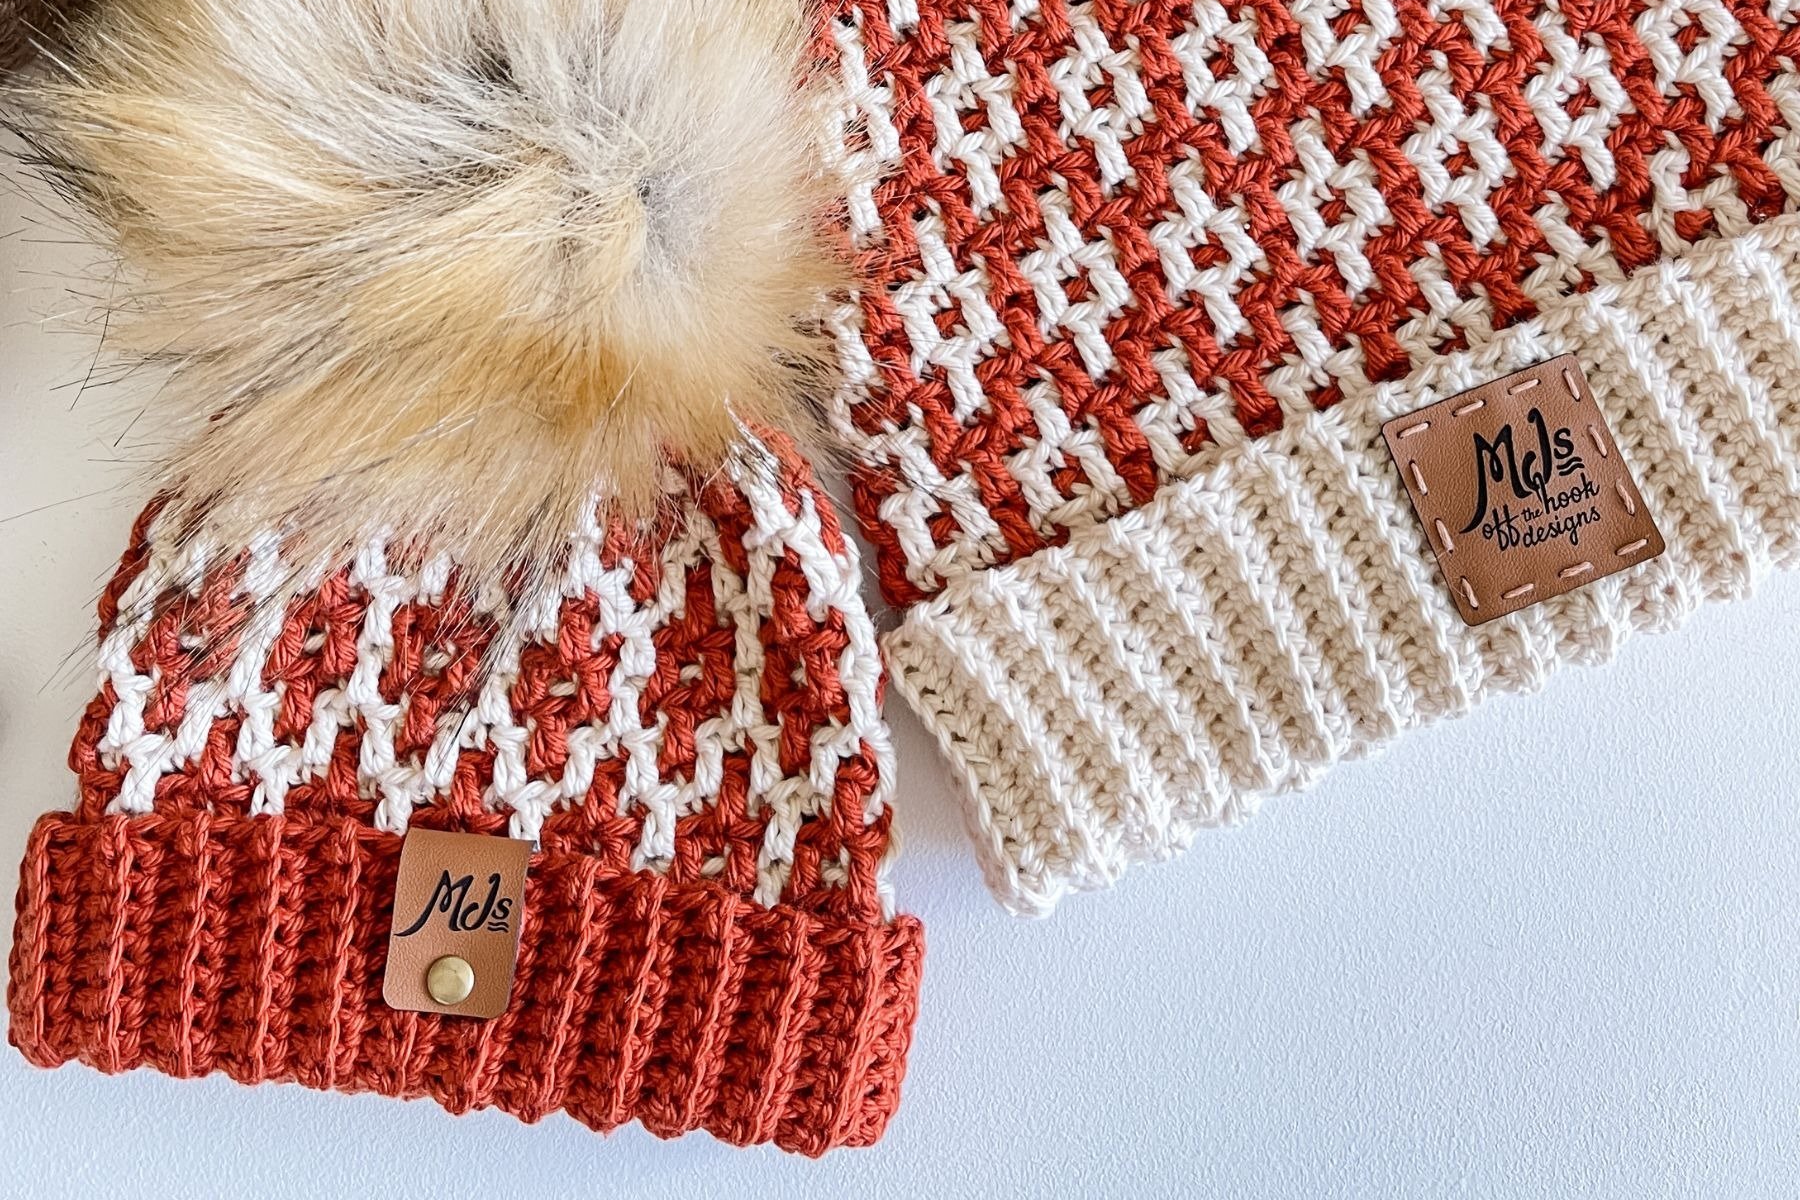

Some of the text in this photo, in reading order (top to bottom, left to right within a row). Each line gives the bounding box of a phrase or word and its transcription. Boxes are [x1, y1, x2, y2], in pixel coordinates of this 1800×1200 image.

[1482, 472, 1600, 551] off the hook
[1522, 505, 1601, 548] designs
